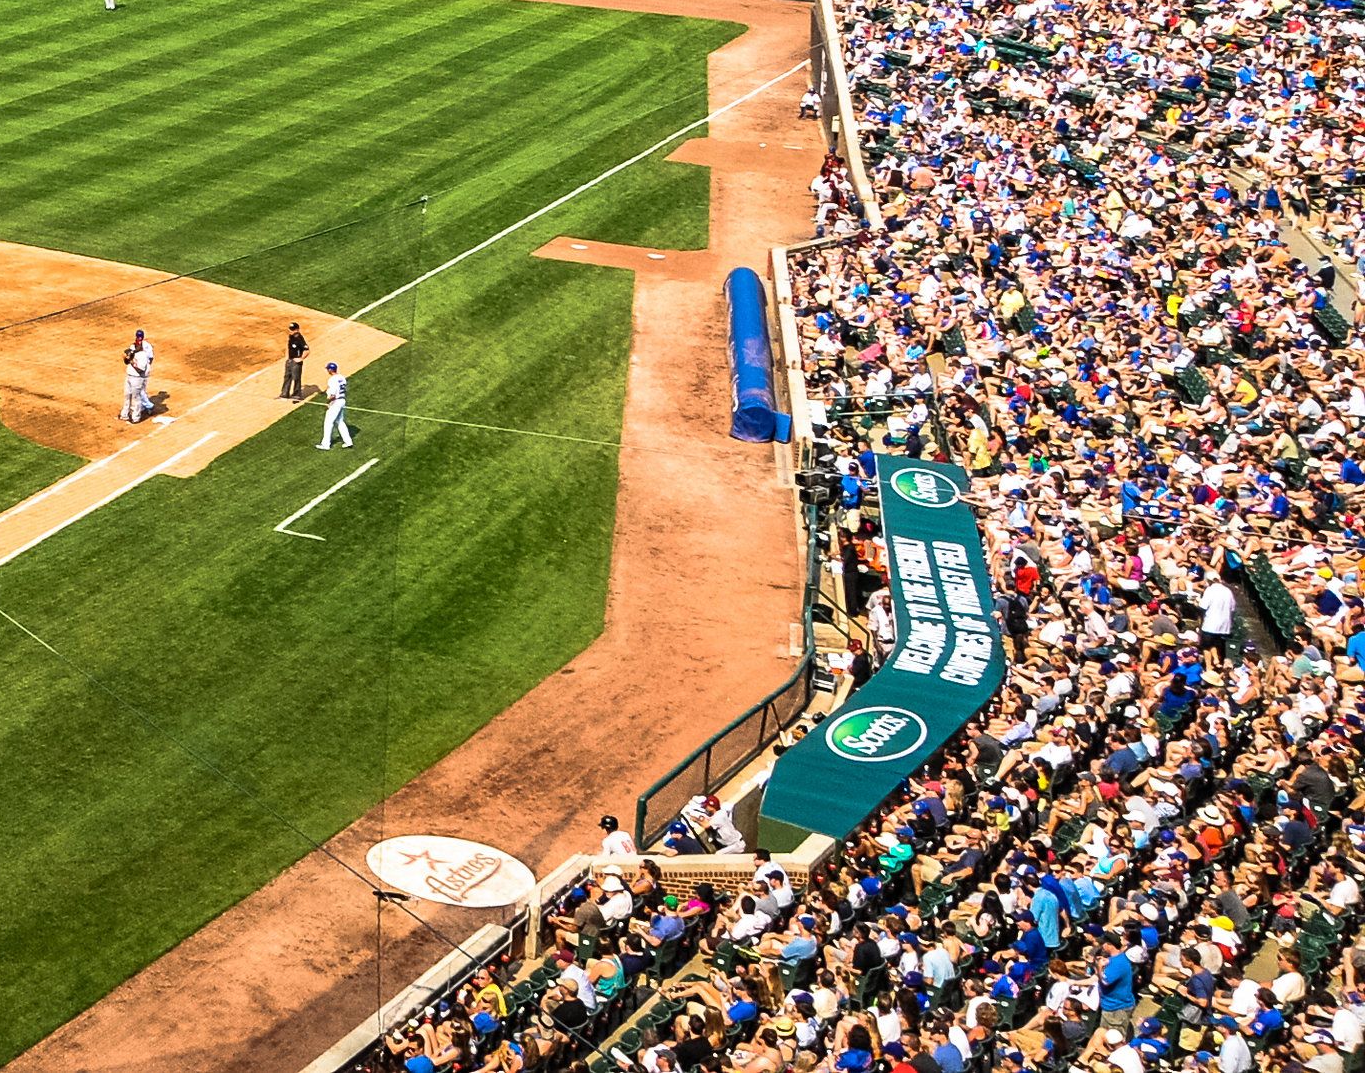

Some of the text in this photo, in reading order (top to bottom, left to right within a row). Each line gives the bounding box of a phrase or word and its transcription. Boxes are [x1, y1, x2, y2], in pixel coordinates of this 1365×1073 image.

[891, 535, 947, 675] WELCOME TO THE FRIENDLY
[931, 540, 993, 686] CONFINES OF WRIGLEY FIELD
[841, 713, 910, 756] Scotts
[424, 852, 502, 902] Astros
